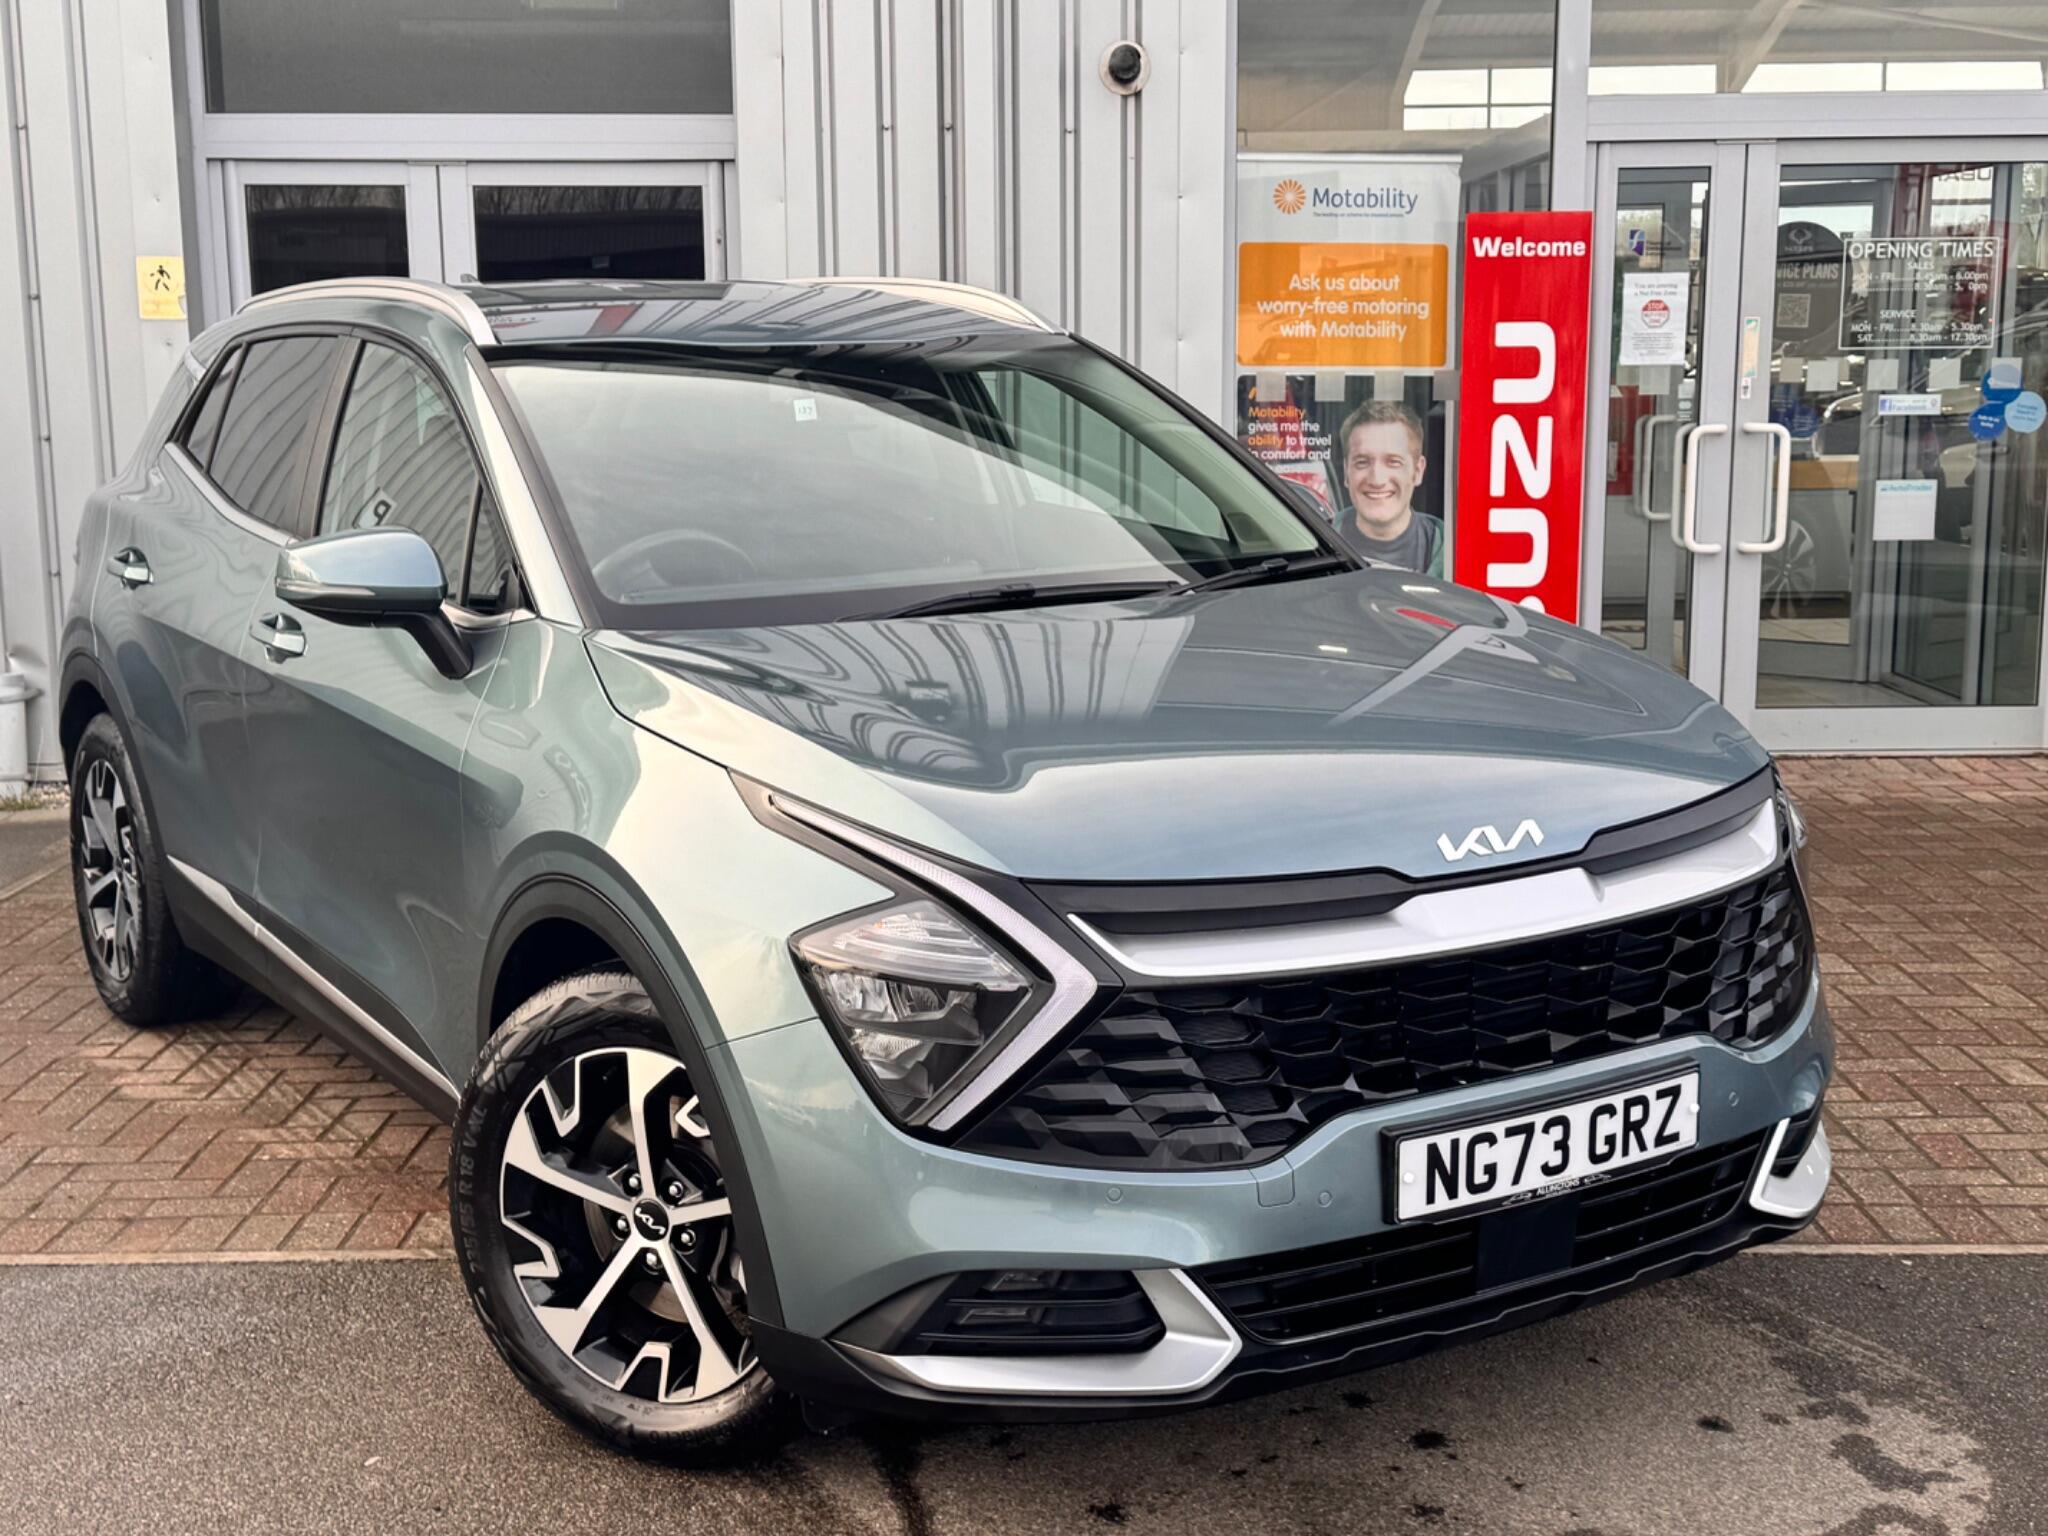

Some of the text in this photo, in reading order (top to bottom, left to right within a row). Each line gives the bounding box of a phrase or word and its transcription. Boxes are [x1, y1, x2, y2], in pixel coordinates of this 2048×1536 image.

[1312, 187, 1418, 215] Motability
[1472, 236, 1586, 258] Welcome
[1848, 241, 1994, 259] OPENING TIMES
[1803, 262, 1839, 280] PLANS
[1907, 261, 1935, 270] SALES
[1289, 274, 1401, 291] Ask us about
[1257, 296, 1430, 319] worry-free motoring
[1880, 310, 1917, 319] SERVICE
[1280, 320, 1407, 342] with Motability
[1851, 323, 1872, 332] MON
[1857, 333, 1873, 343] SAT
[1248, 406, 1306, 420] Motability
[1248, 420, 1320, 435] gives me the
[1248, 433, 1332, 449] ability to travel
[1261, 447, 1306, 460] comfort
[1308, 448, 1332, 460] and
[1436, 818, 1545, 862] KIA
[1425, 1083, 1682, 1205] NG73 GRZ
[460, 1153, 475, 1177] 18
